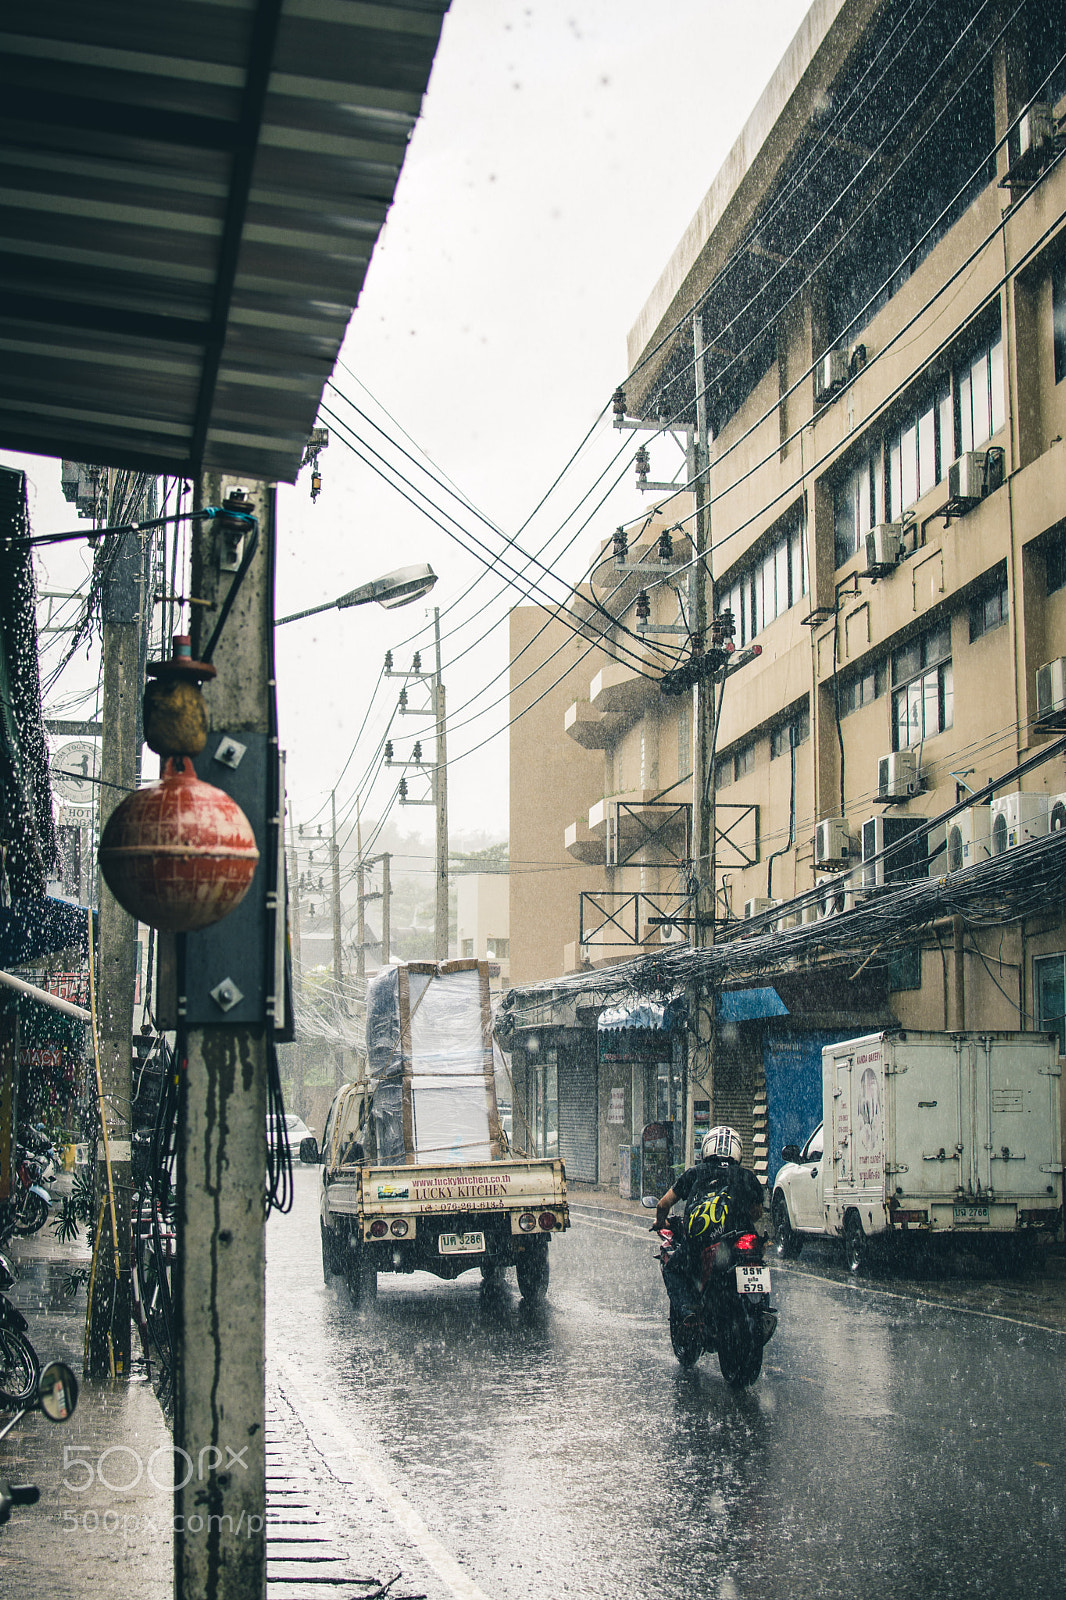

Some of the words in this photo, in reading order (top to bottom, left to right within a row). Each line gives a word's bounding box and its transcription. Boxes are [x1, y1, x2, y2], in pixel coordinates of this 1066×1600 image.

[68, 809, 91, 818] HOT
[65, 818, 93, 827] YOGA
[19, 1051, 60, 1064] MACY
[412, 1175, 510, 1187] www.luckykitchen.co.th
[415, 1187, 454, 1200] LUCKY
[458, 1184, 507, 1197] KITCHEN
[743, 1284, 763, 1292] 579
